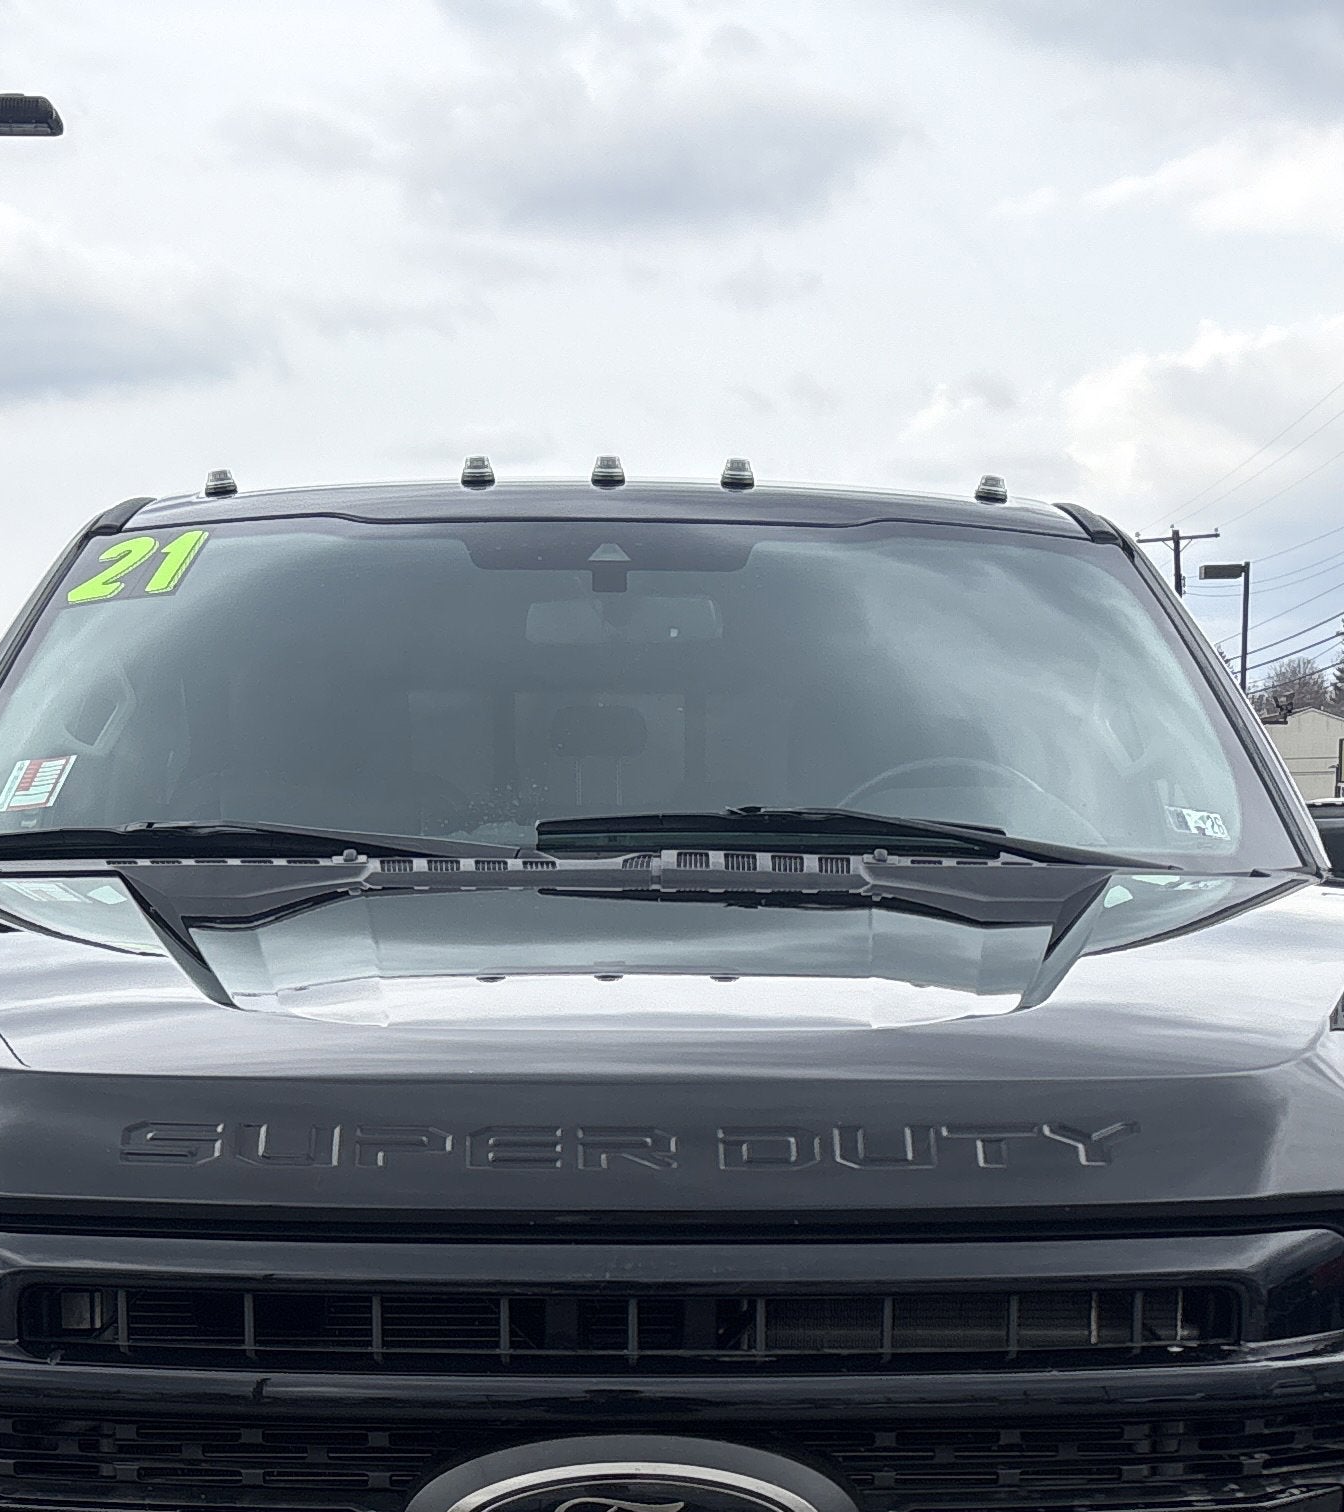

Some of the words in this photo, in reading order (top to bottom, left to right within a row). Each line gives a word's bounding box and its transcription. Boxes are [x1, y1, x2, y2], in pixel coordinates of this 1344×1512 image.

[67, 530, 209, 604] 21
[120, 1119, 679, 1170] SUPER
[717, 1120, 1142, 1170] DUTY
